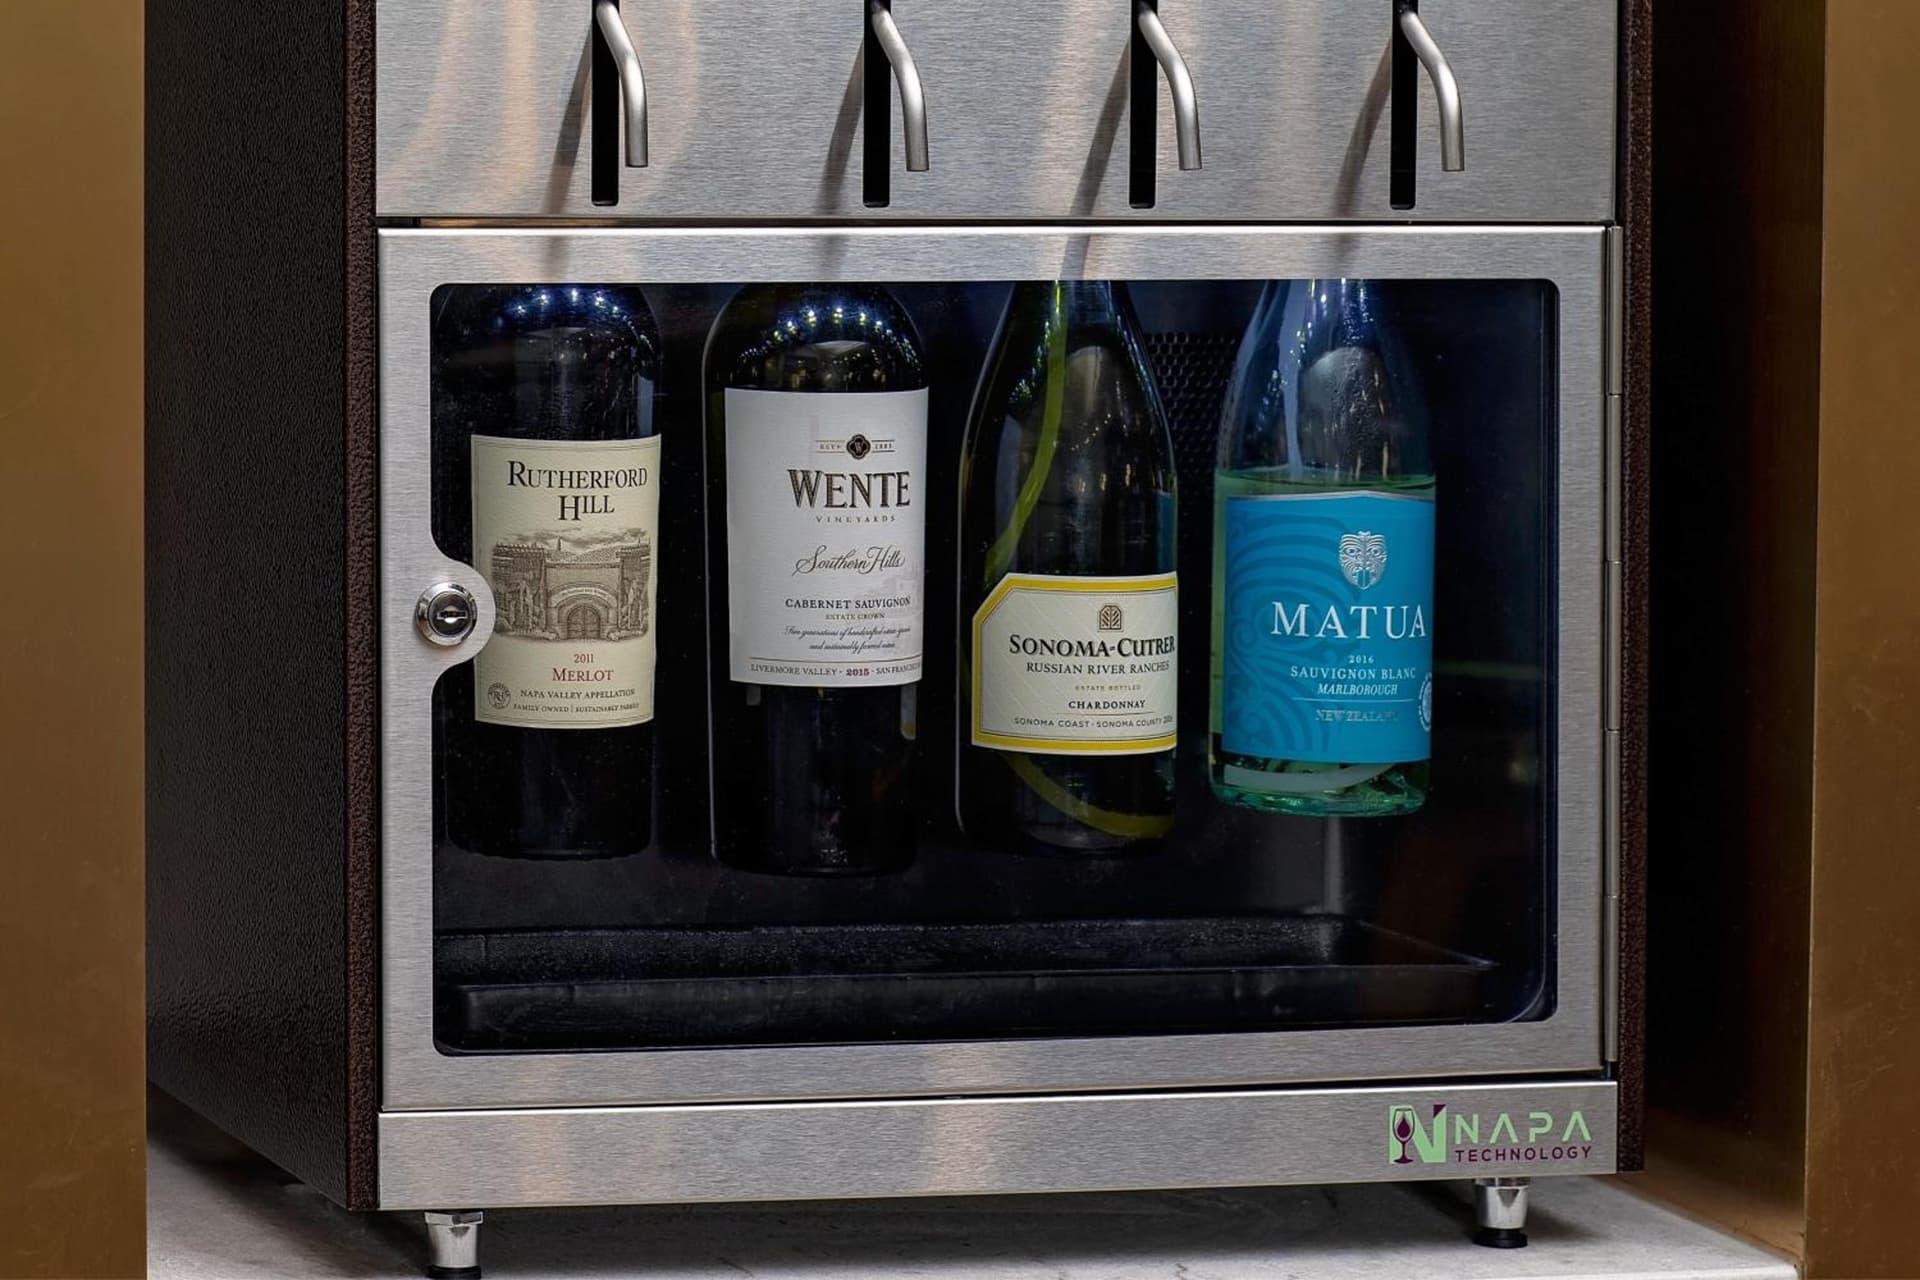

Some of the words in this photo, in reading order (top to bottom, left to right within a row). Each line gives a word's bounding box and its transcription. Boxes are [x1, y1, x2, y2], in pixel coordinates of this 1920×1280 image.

[507, 460, 648, 489] RUTHERFORD
[786, 469, 911, 508] WENTE
[558, 495, 615, 521] HILL
[815, 515, 897, 523] VINEYARDS
[791, 544, 869, 577] Southern
[858, 544, 906, 575] Hills
[785, 598, 852, 609] CABERNET
[854, 595, 911, 609] SAUVIGNON
[1271, 601, 1427, 640] MATUA
[1009, 634, 1176, 658] SONOMA-CUTRER
[573, 653, 594, 664] 2011
[1348, 655, 1375, 664] 2016
[552, 667, 614, 682] MERLOT
[750, 663, 802, 675] LIVERMORE
[802, 665, 839, 676] VALLEY
[845, 667, 870, 677] 2015
[1026, 661, 1083, 674] RUSSIAN
[1087, 664, 1126, 675] RIVER
[1130, 660, 1170, 675] RANCHES
[1290, 665, 1376, 680] SAUVIGNON
[1381, 667, 1417, 680] BLANC
[520, 689, 545, 698] NAPA
[548, 690, 582, 700] VALLEY
[585, 688, 636, 699] APPELLATION
[1317, 683, 1398, 695] MARLBOROUGH
[513, 703, 539, 712] FAMILY
[541, 705, 569, 713] OWNED
[1068, 699, 1146, 710] CHARDONNAY
[1315, 709, 1344, 721] NEW
[1014, 717, 1055, 727] SONOMA
[1058, 719, 1089, 728] COAST
[1096, 718, 1134, 728] SONOMA
[1455, 1111, 1592, 1145] NAPA
[1455, 1146, 1592, 1163] TECHNOLOGY
